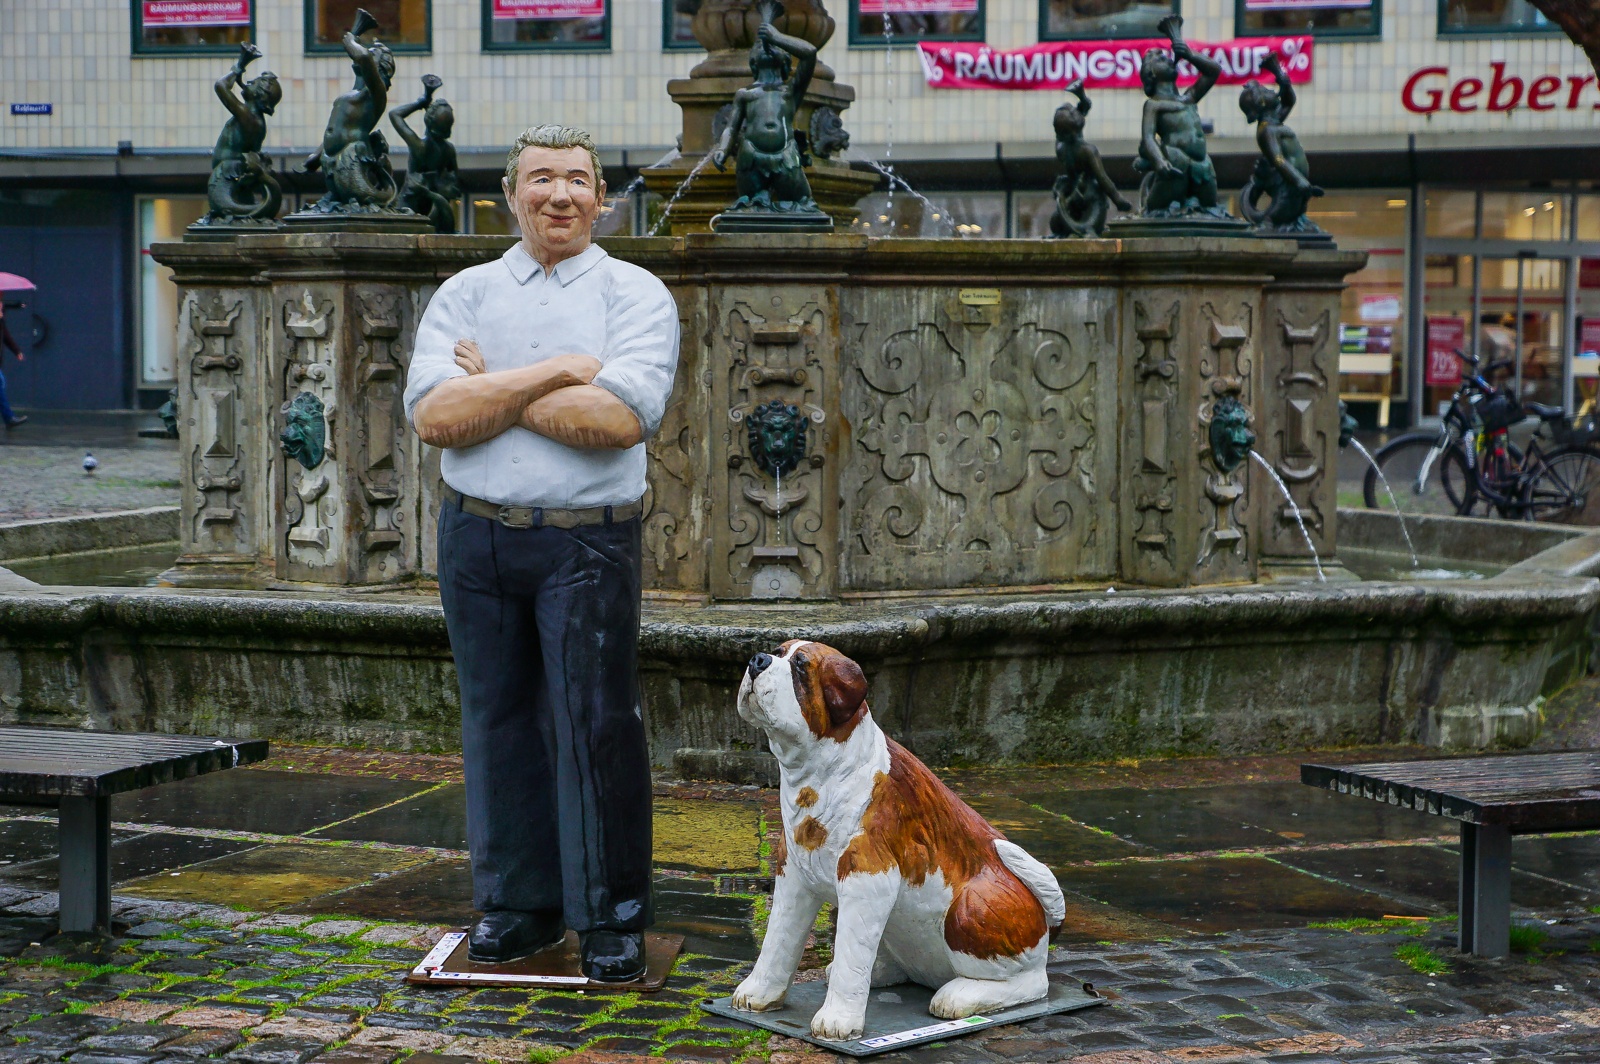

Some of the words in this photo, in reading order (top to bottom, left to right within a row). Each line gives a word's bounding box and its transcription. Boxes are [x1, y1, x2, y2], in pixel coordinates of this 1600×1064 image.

[150, 3, 243, 12] RÄUMUNGSVERKAUF
[954, 46, 1270, 82] RÄUMUNGSVAUF
[1282, 37, 1309, 71] %
[1401, 62, 1600, 114] Geber
[1431, 350, 1458, 371] 70%
